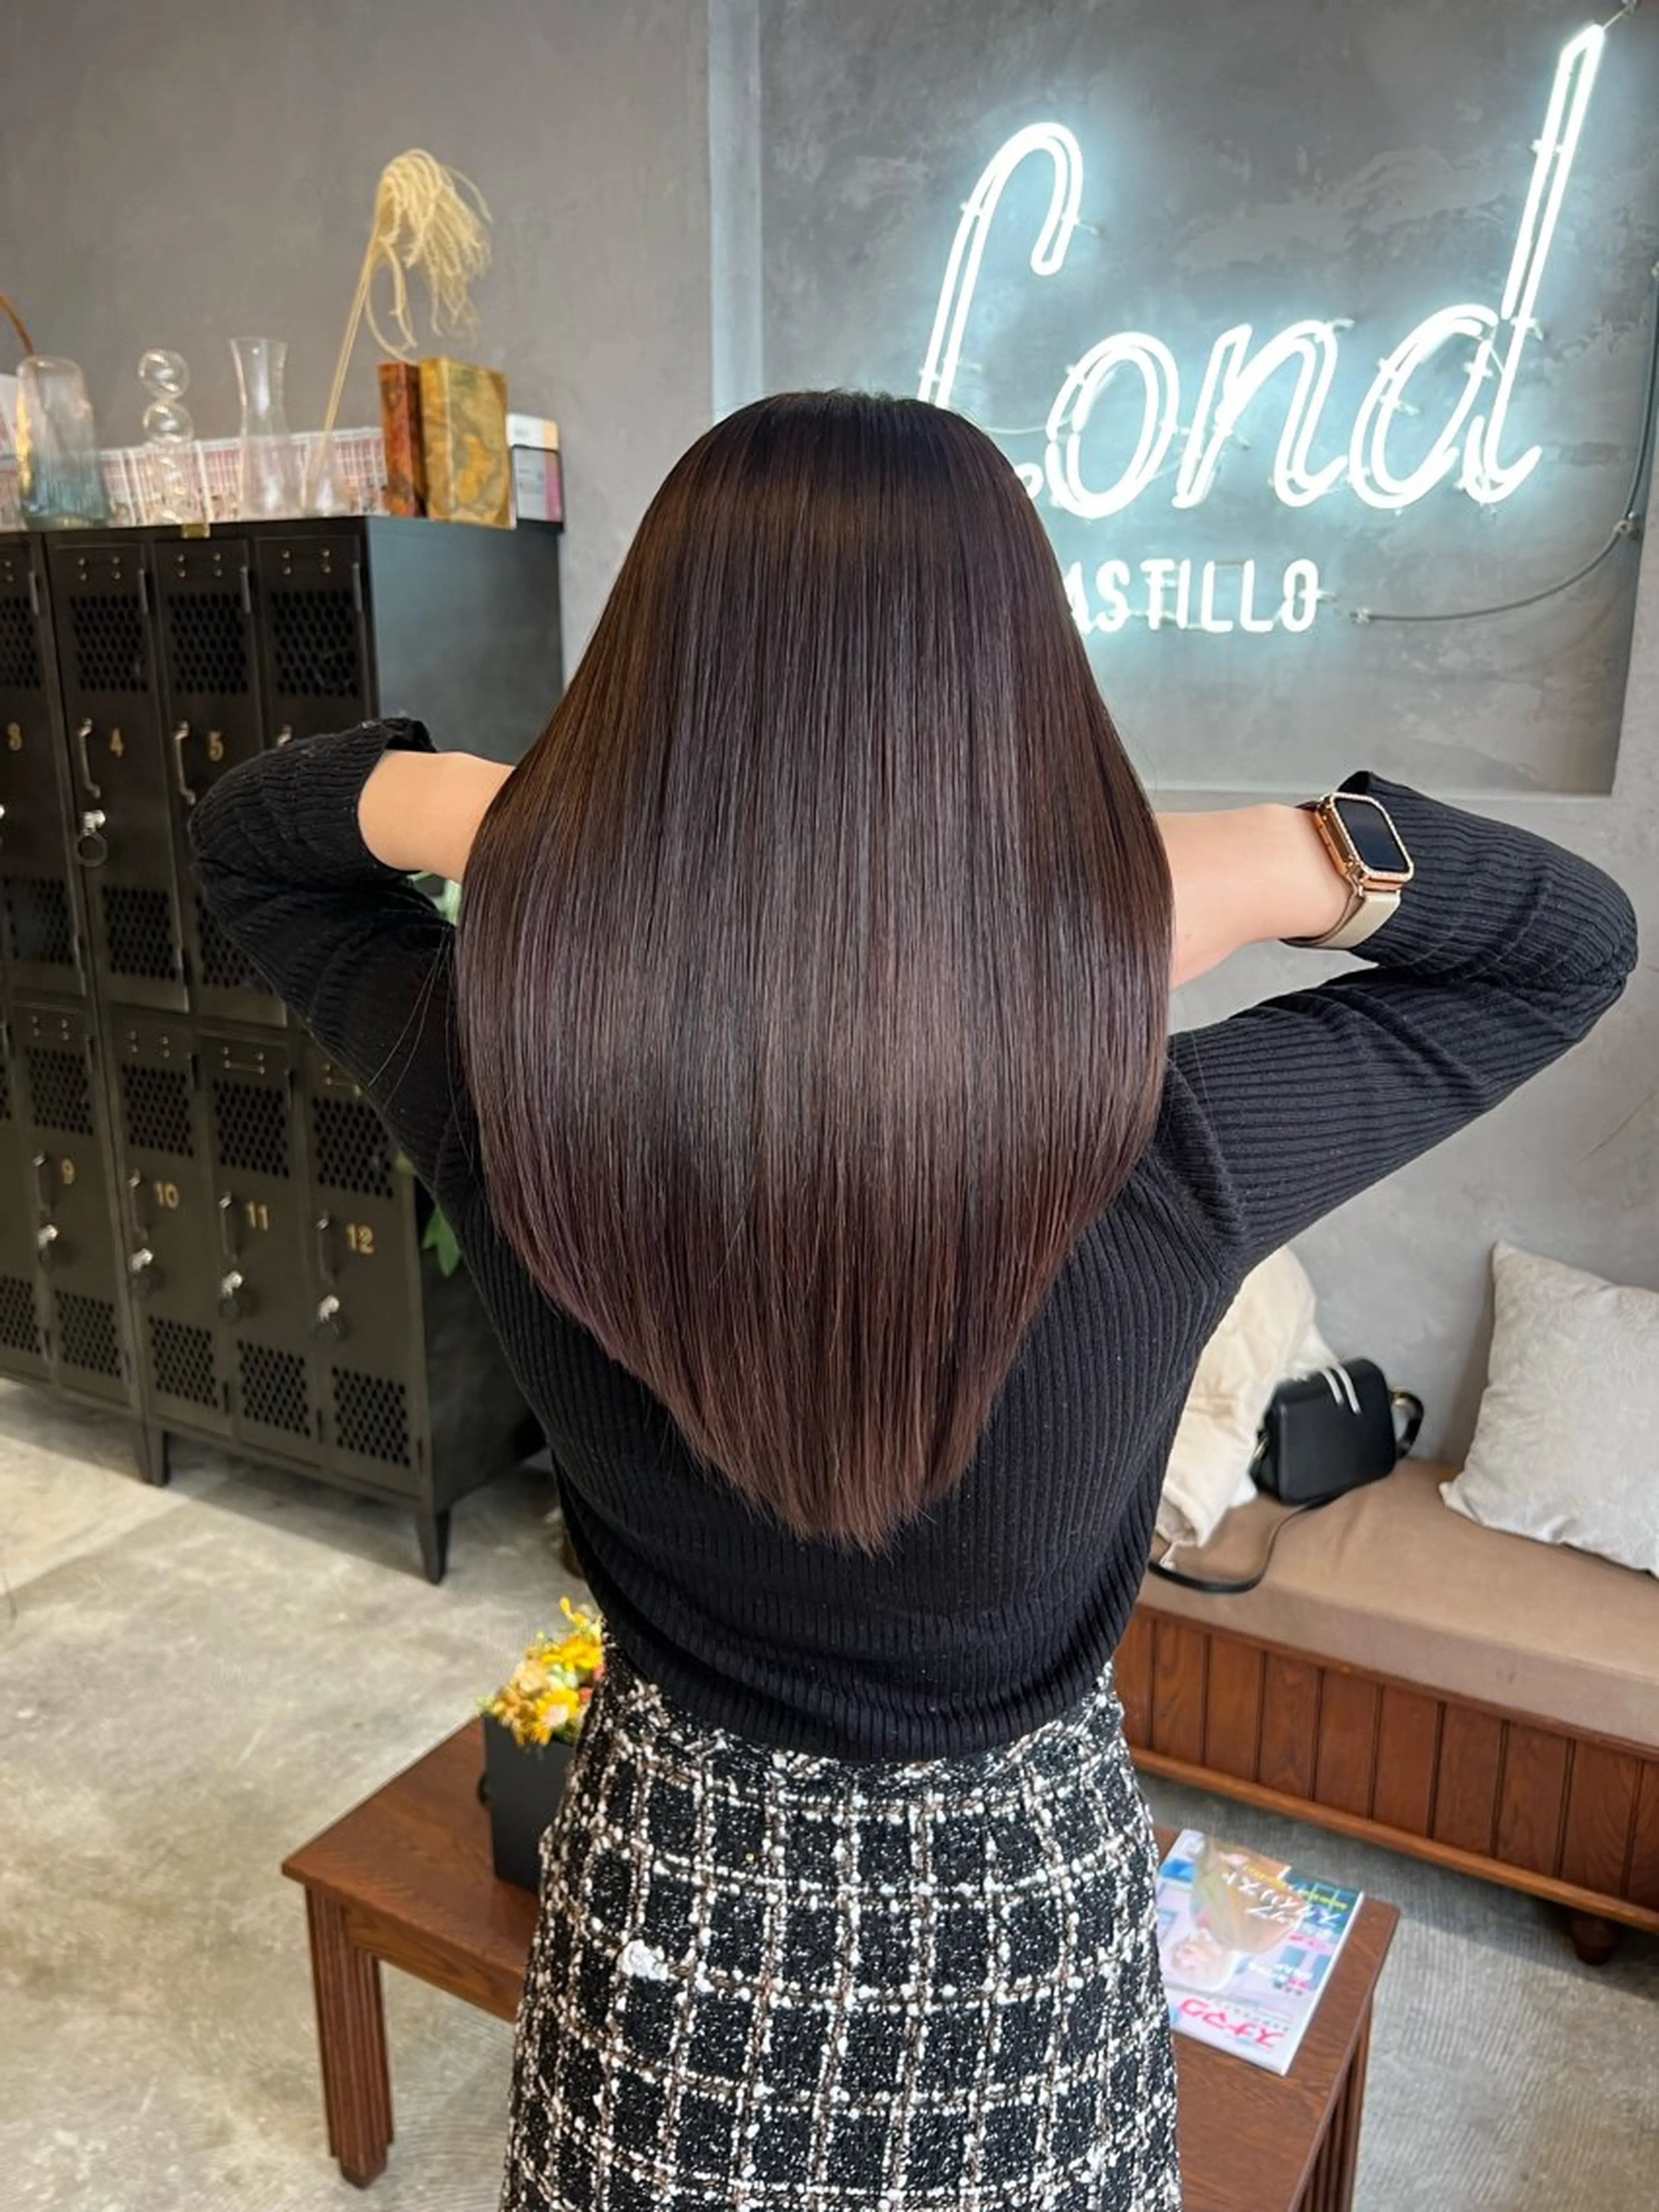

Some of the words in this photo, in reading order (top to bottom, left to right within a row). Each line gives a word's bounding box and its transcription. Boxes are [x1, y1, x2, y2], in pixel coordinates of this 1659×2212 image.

[110, 728, 124, 757] 4
[208, 731, 224, 761] 5
[62, 1158, 75, 1185] 9
[155, 1182, 178, 1208] 10
[248, 1202, 269, 1230] 11
[347, 1225, 374, 1254] 12
